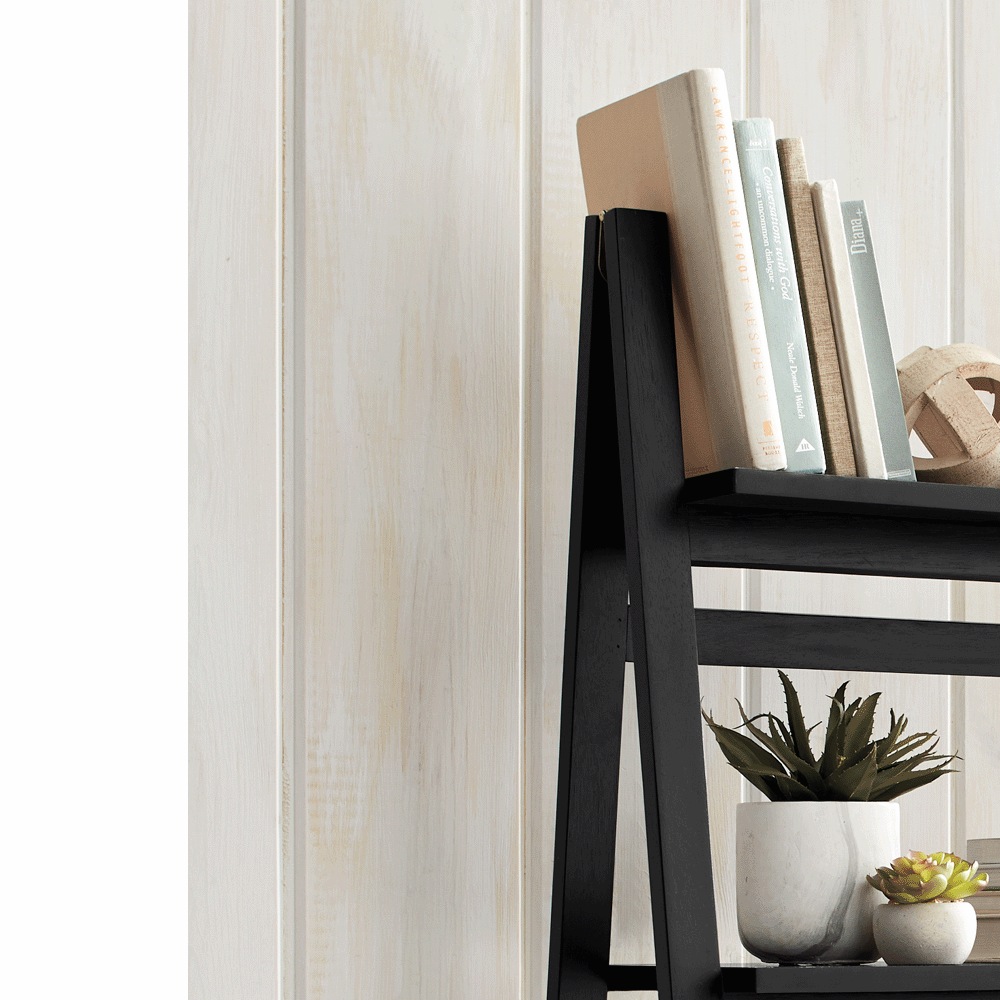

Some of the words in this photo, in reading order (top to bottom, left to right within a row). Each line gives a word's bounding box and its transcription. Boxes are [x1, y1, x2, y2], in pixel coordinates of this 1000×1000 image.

[755, 187, 763, 200] an
[762, 166, 782, 245] Conversations
[757, 201, 769, 247] uncommon
[850, 218, 868, 255] Diana
[764, 248, 775, 284] dialogue
[777, 247, 789, 273] with
[780, 273, 794, 301] God
[743, 301, 769, 402] RESPECT
[786, 342, 794, 364] Neale
[790, 365, 801, 393] Donald
